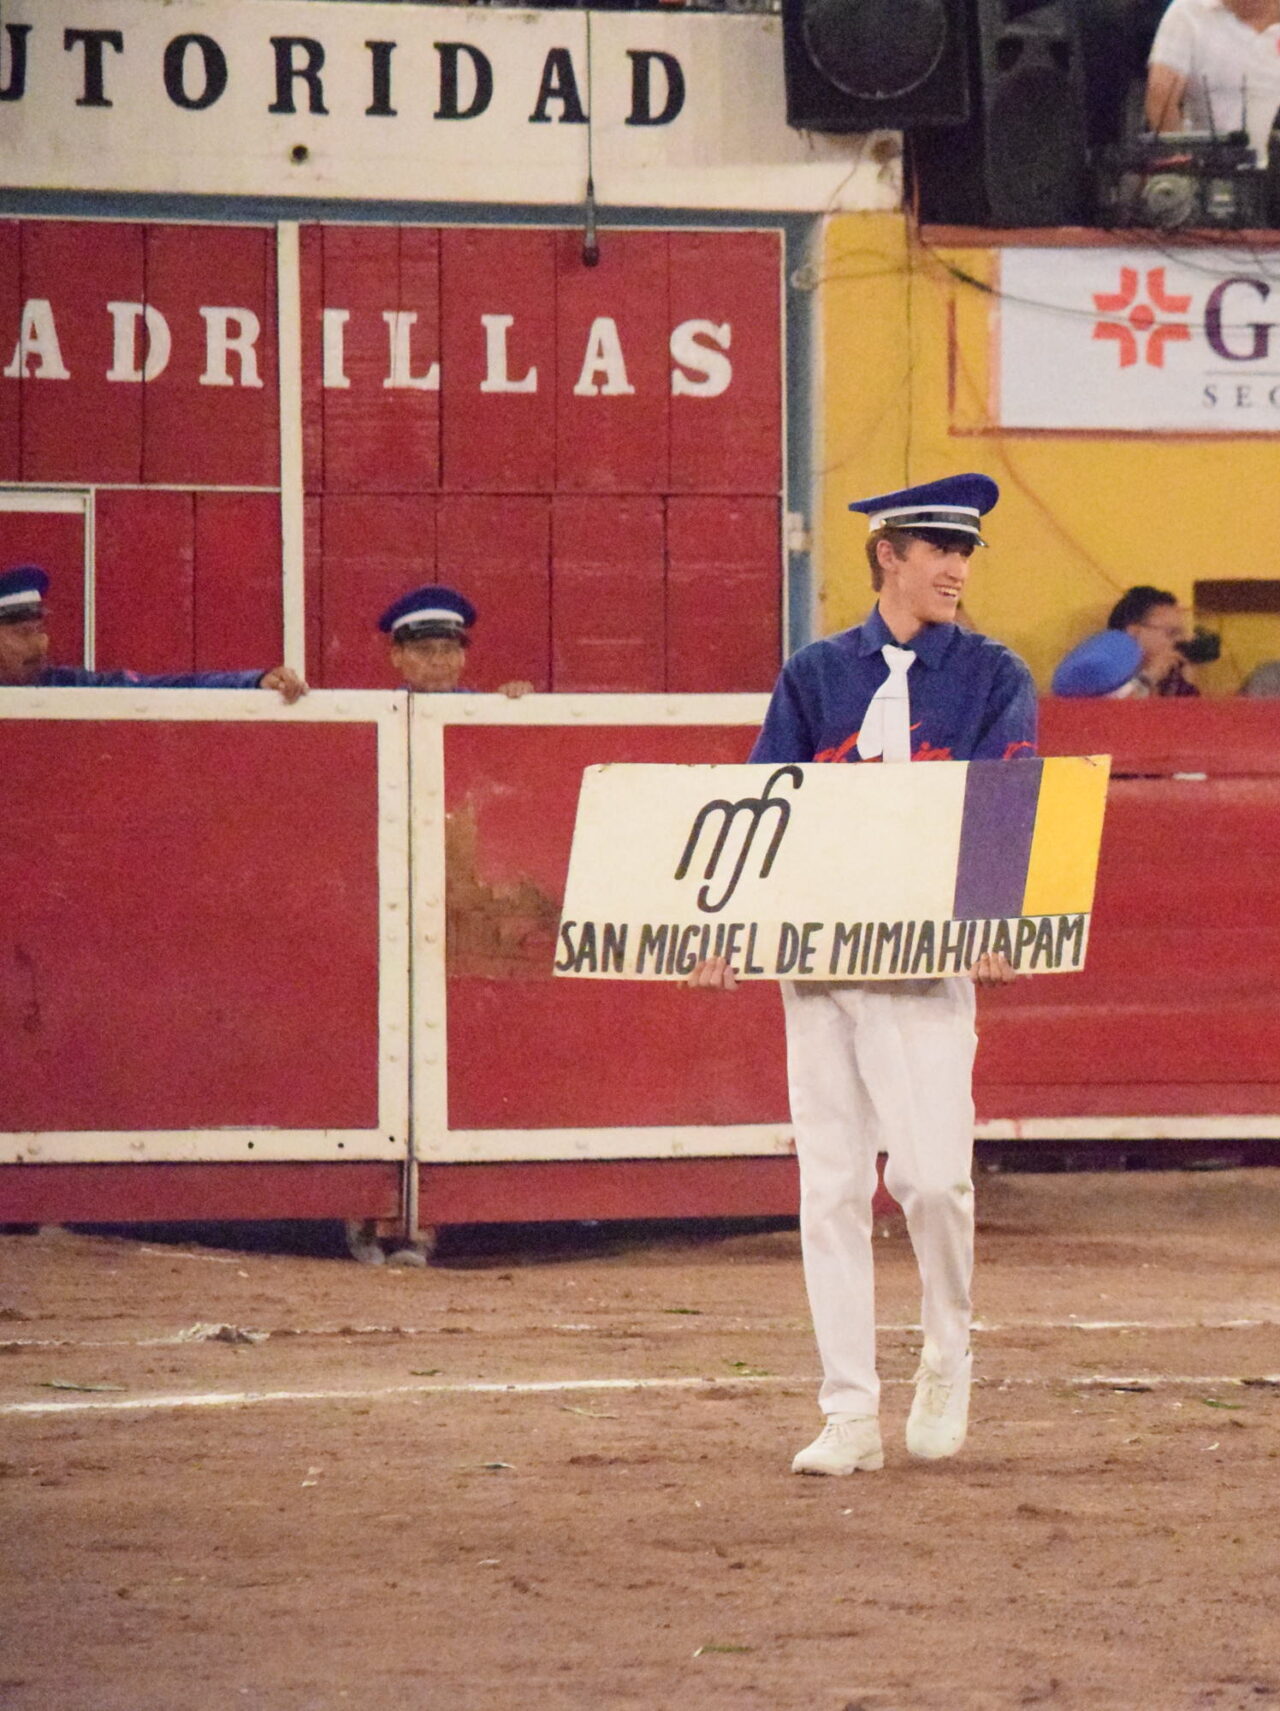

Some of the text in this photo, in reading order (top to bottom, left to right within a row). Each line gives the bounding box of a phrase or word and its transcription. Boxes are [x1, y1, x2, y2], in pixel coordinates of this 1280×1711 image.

[3, 299, 733, 397] ADRILLAS
[555, 914, 1085, 976] SAN MIGUEL DE MIMIAHUAPAM
